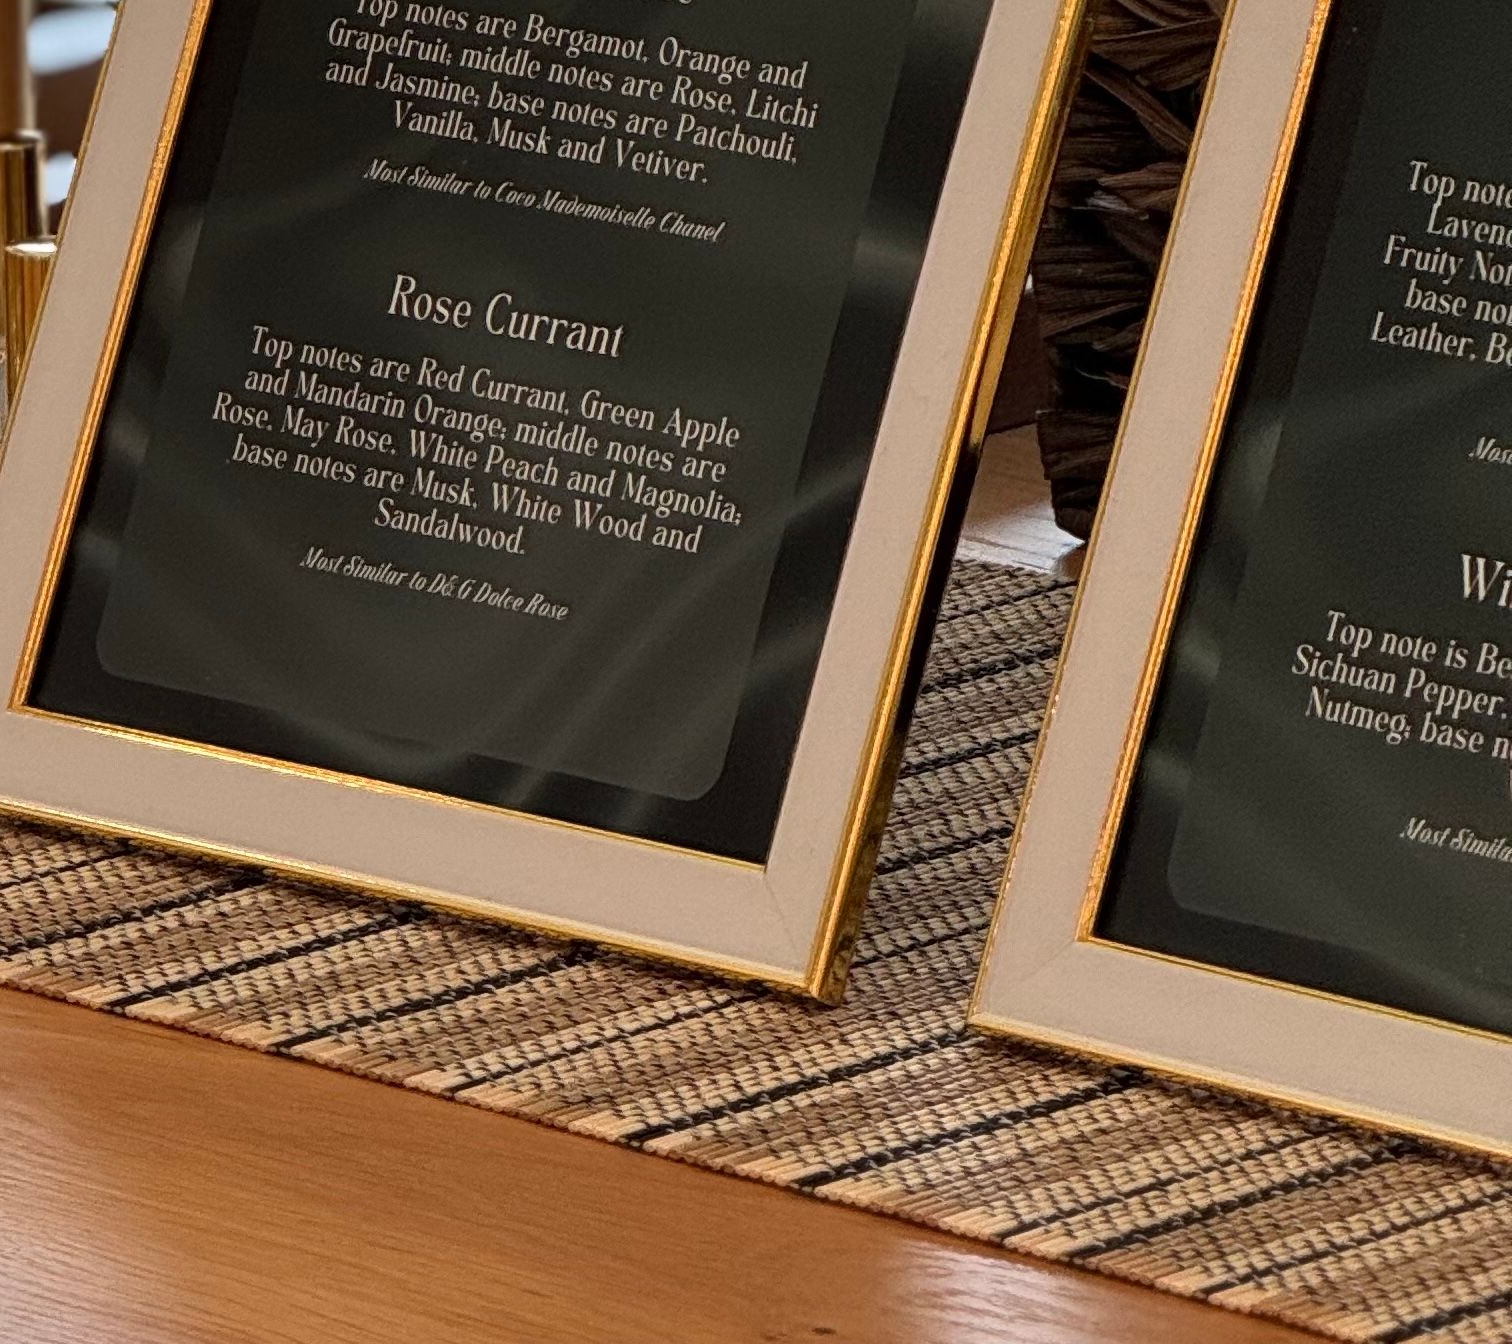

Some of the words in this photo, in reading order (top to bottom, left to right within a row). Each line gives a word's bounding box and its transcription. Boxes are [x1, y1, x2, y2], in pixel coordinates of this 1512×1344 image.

[404, 3, 469, 31] notes
[475, 15, 517, 39] are
[658, 36, 751, 85] Orange
[757, 60, 809, 90] and
[325, 57, 369, 87] and
[487, 80, 545, 117] base
[550, 100, 618, 130] notes
[625, 113, 668, 139] are
[459, 45, 541, 80] middle
[547, 63, 614, 92] notes
[620, 76, 664, 101] are
[745, 88, 819, 129] Litchi
[486, 116, 551, 155] Musk
[557, 135, 606, 164] and
[616, 137, 708, 184] Vetiver.
[1409, 160, 1456, 207] Top
[363, 158, 409, 184] Most
[406, 166, 473, 195] Similar
[473, 180, 492, 200] to
[494, 181, 537, 207] Coco
[536, 189, 656, 230] Mademoiselle
[659, 212, 726, 242] Chanel
[1384, 234, 1464, 285] Fruity
[1404, 277, 1467, 317] base
[387, 274, 472, 328] Rose
[485, 292, 624, 358] Currant
[244, 368, 291, 396] and
[294, 370, 406, 419] Mandarin
[513, 421, 599, 457] middle
[605, 441, 675, 472] notes
[681, 456, 727, 483] are
[252, 324, 293, 369] Top
[299, 344, 363, 374] notes
[369, 357, 411, 383] are
[416, 357, 466, 393] Red
[580, 389, 655, 431] Green
[661, 407, 740, 452] Apple
[280, 404, 330, 449] May
[410, 428, 478, 470] White
[483, 444, 559, 487] Peach
[566, 469, 617, 498] and
[232, 432, 288, 470] base
[293, 453, 357, 483] notes
[363, 467, 405, 493] are
[491, 481, 562, 524] White
[574, 498, 648, 542] Wood
[651, 524, 703, 554] and
[374, 497, 525, 555] Sandalwood.
[299, 546, 345, 574] Most
[342, 555, 409, 586] Similar
[407, 571, 427, 591] to
[472, 582, 525, 611] Dolce
[522, 593, 569, 621] Rose
[1291, 643, 1396, 694] Sichuan
[1327, 610, 1373, 657] Top
[1381, 633, 1438, 663] note
[1444, 639, 1469, 669] is
[1419, 711, 1485, 754] base
[1399, 815, 1450, 847] Most
